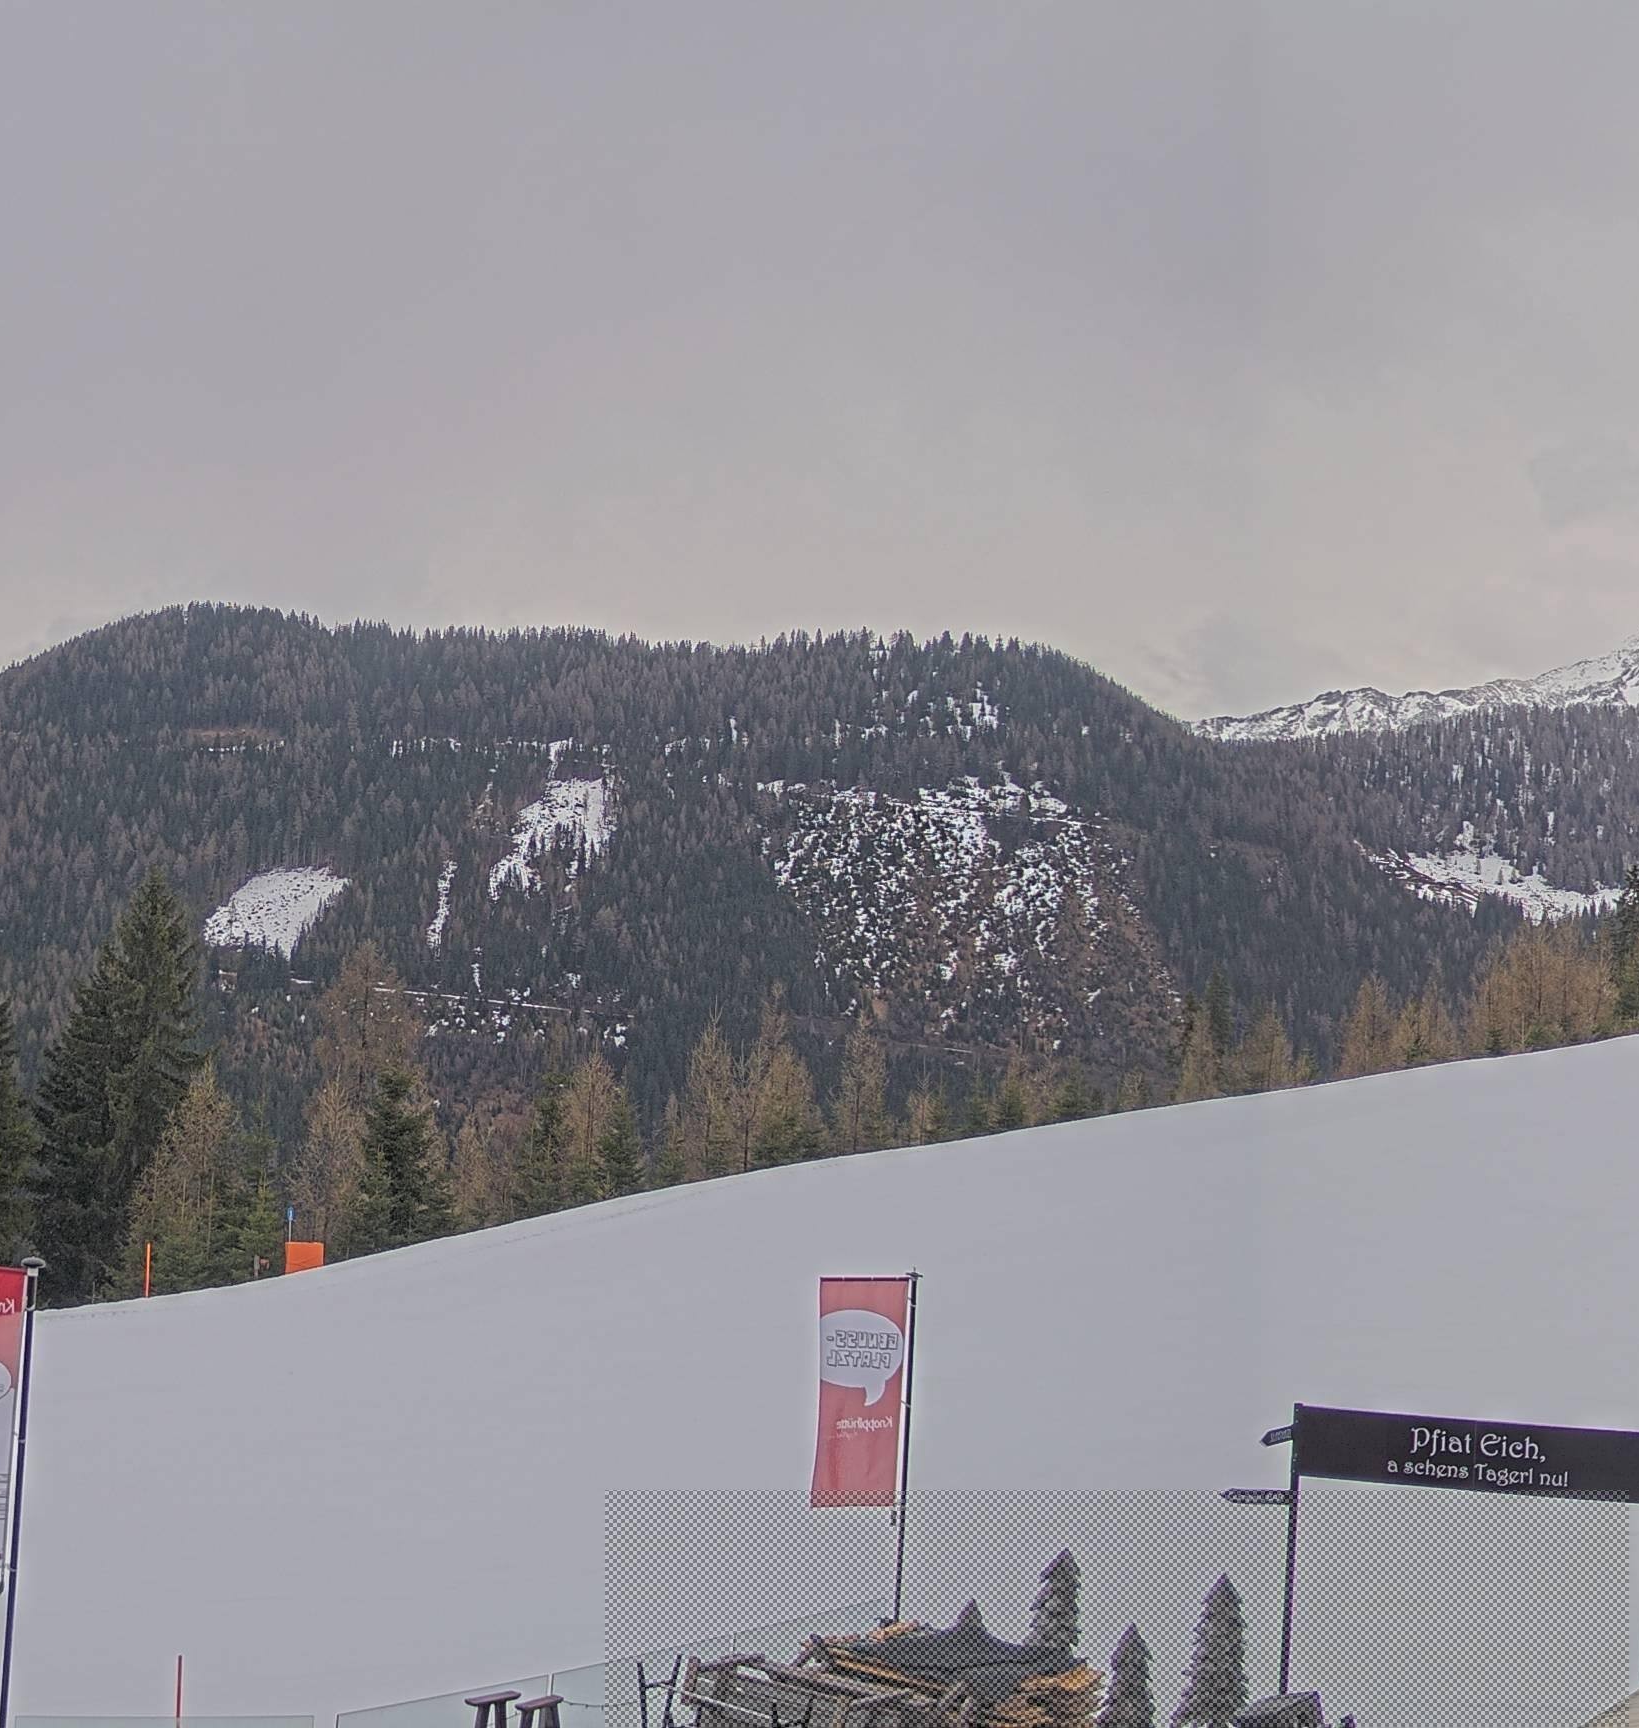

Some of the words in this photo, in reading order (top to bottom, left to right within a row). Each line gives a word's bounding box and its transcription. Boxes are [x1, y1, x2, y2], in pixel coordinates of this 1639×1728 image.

[1410, 1427, 1472, 1456] Pfiat
[1480, 1433, 1546, 1463] Eich,
[1387, 1460, 1398, 1473] a
[1403, 1459, 1469, 1479] schens
[1474, 1463, 1533, 1487] Tagerl
[1540, 1471, 1568, 1487] nu!
